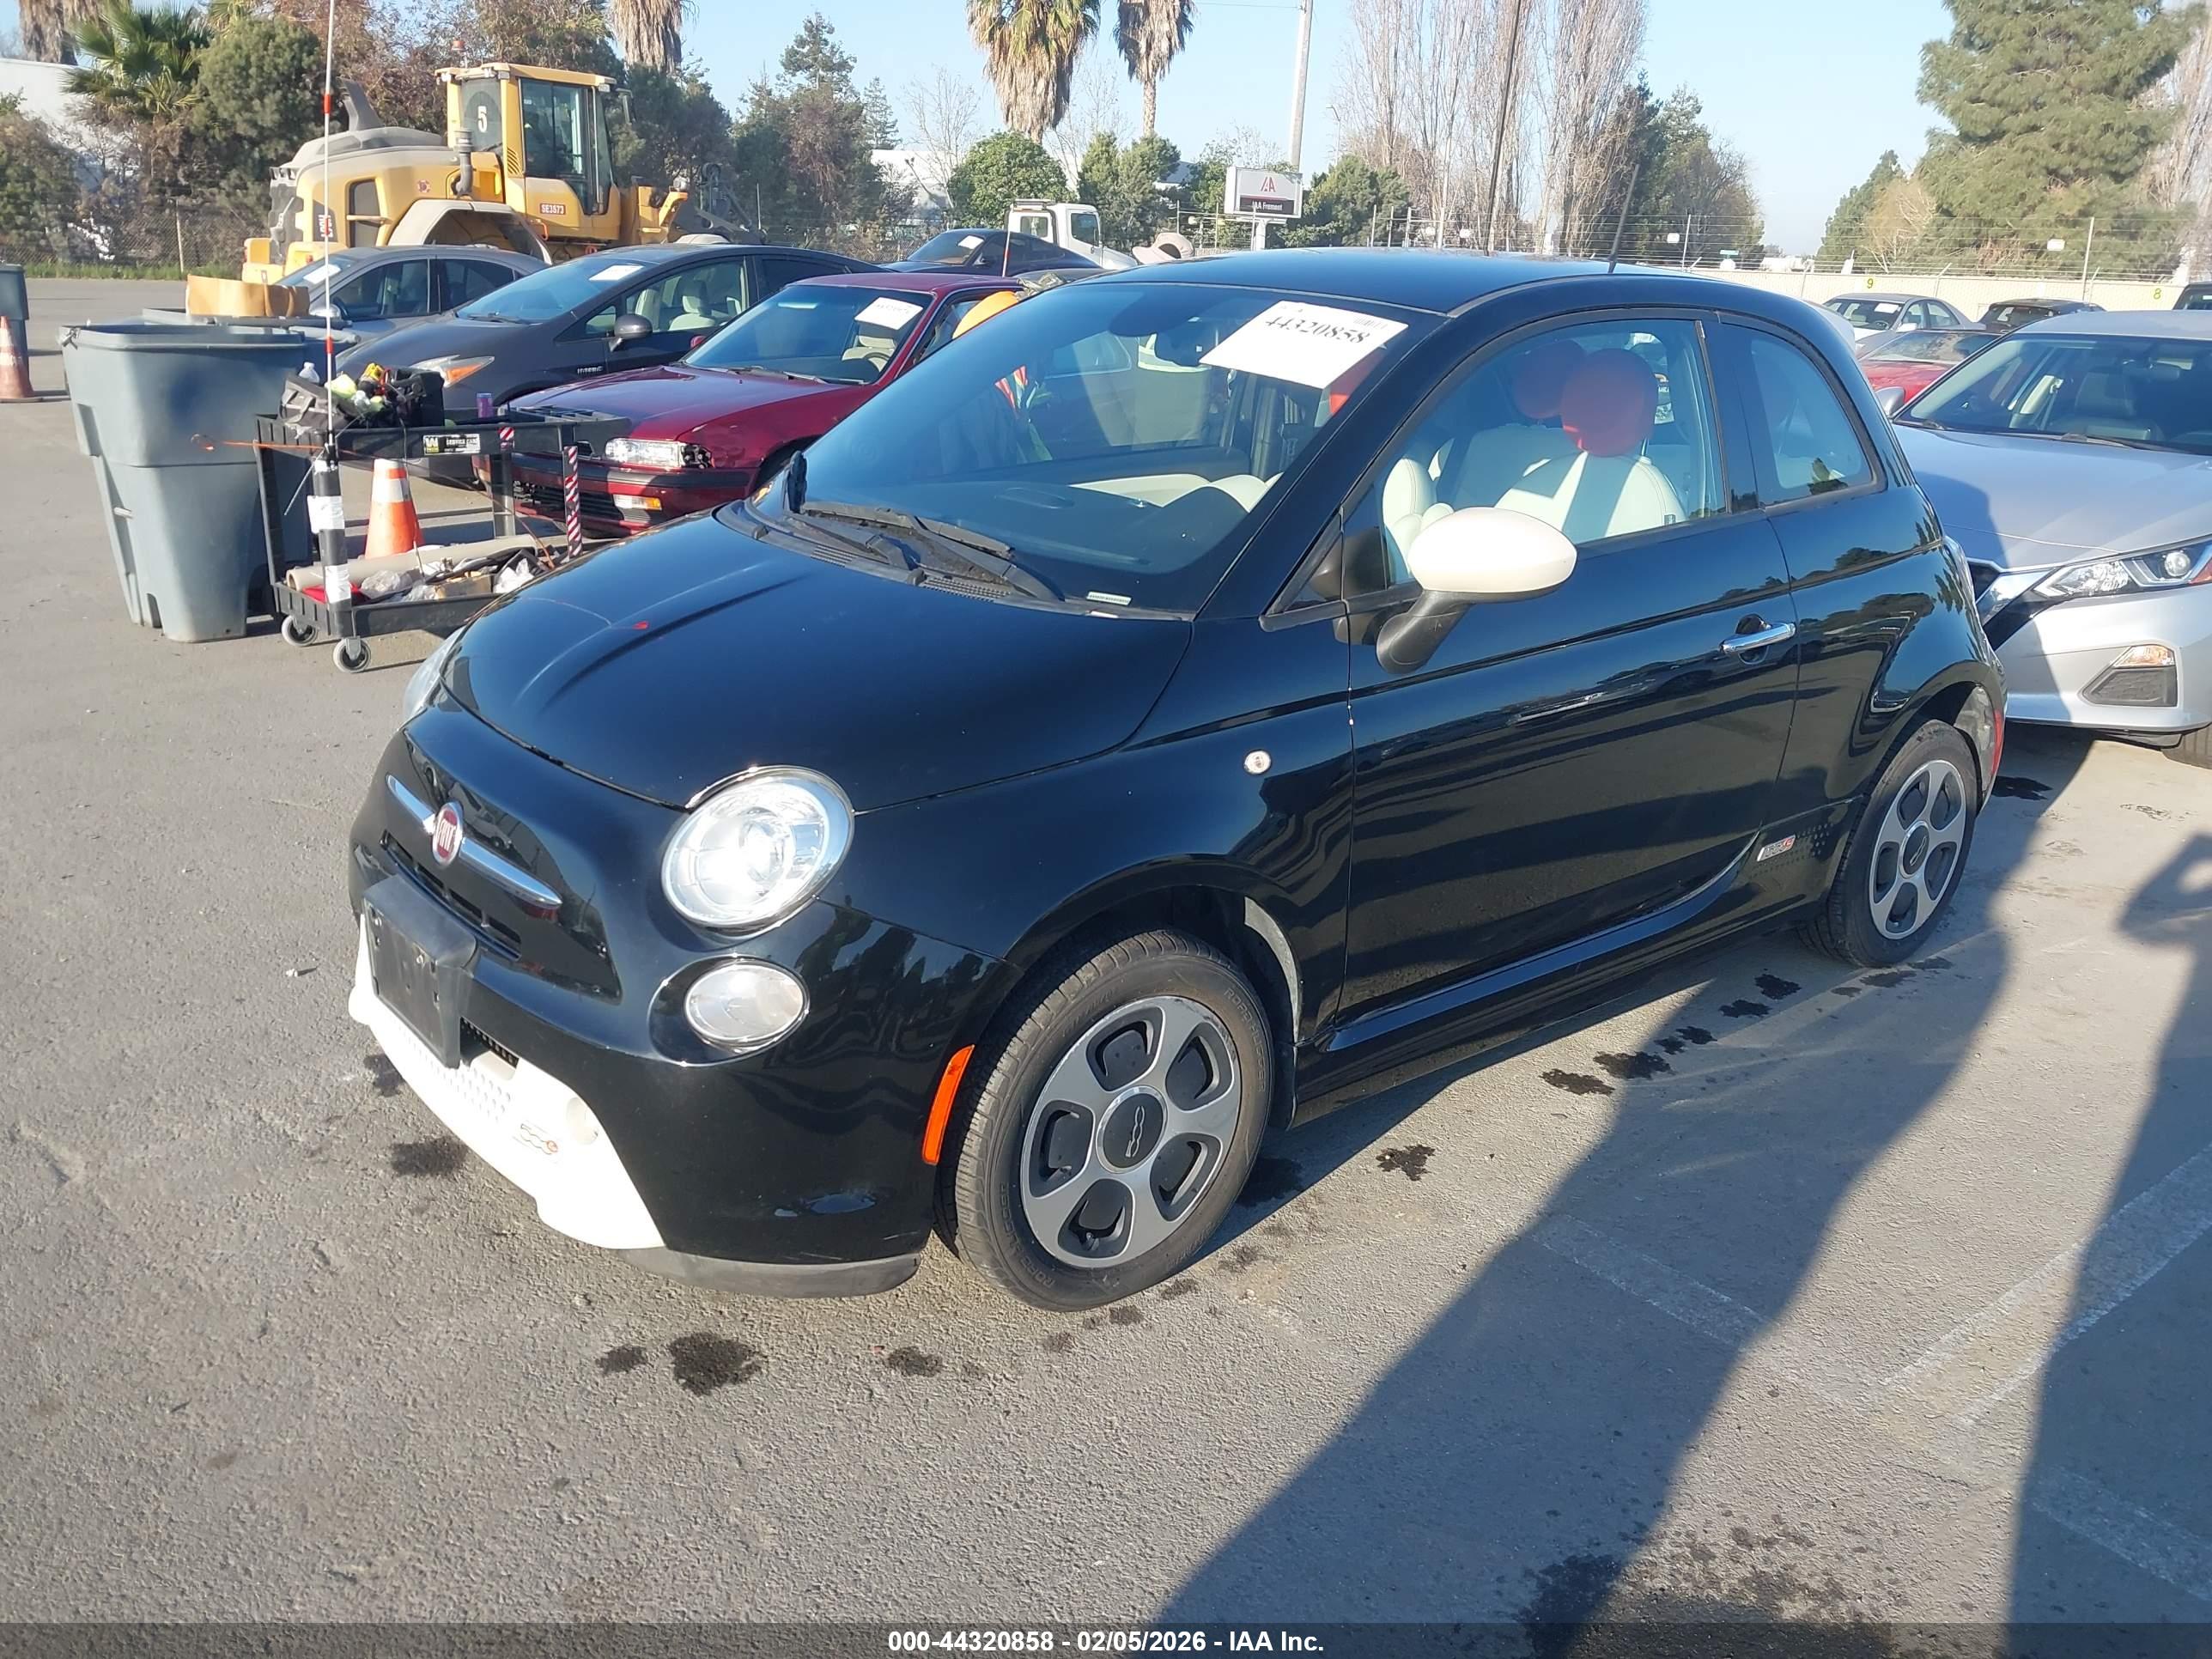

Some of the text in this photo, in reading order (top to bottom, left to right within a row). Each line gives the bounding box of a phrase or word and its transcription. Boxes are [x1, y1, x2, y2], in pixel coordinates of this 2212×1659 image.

[477, 106, 488, 133] 5
[1262, 201, 1283, 211] Fremont
[1867, 277, 1874, 289] 9
[2153, 288, 2162, 300] 8
[1265, 315, 1371, 343] 44320858
